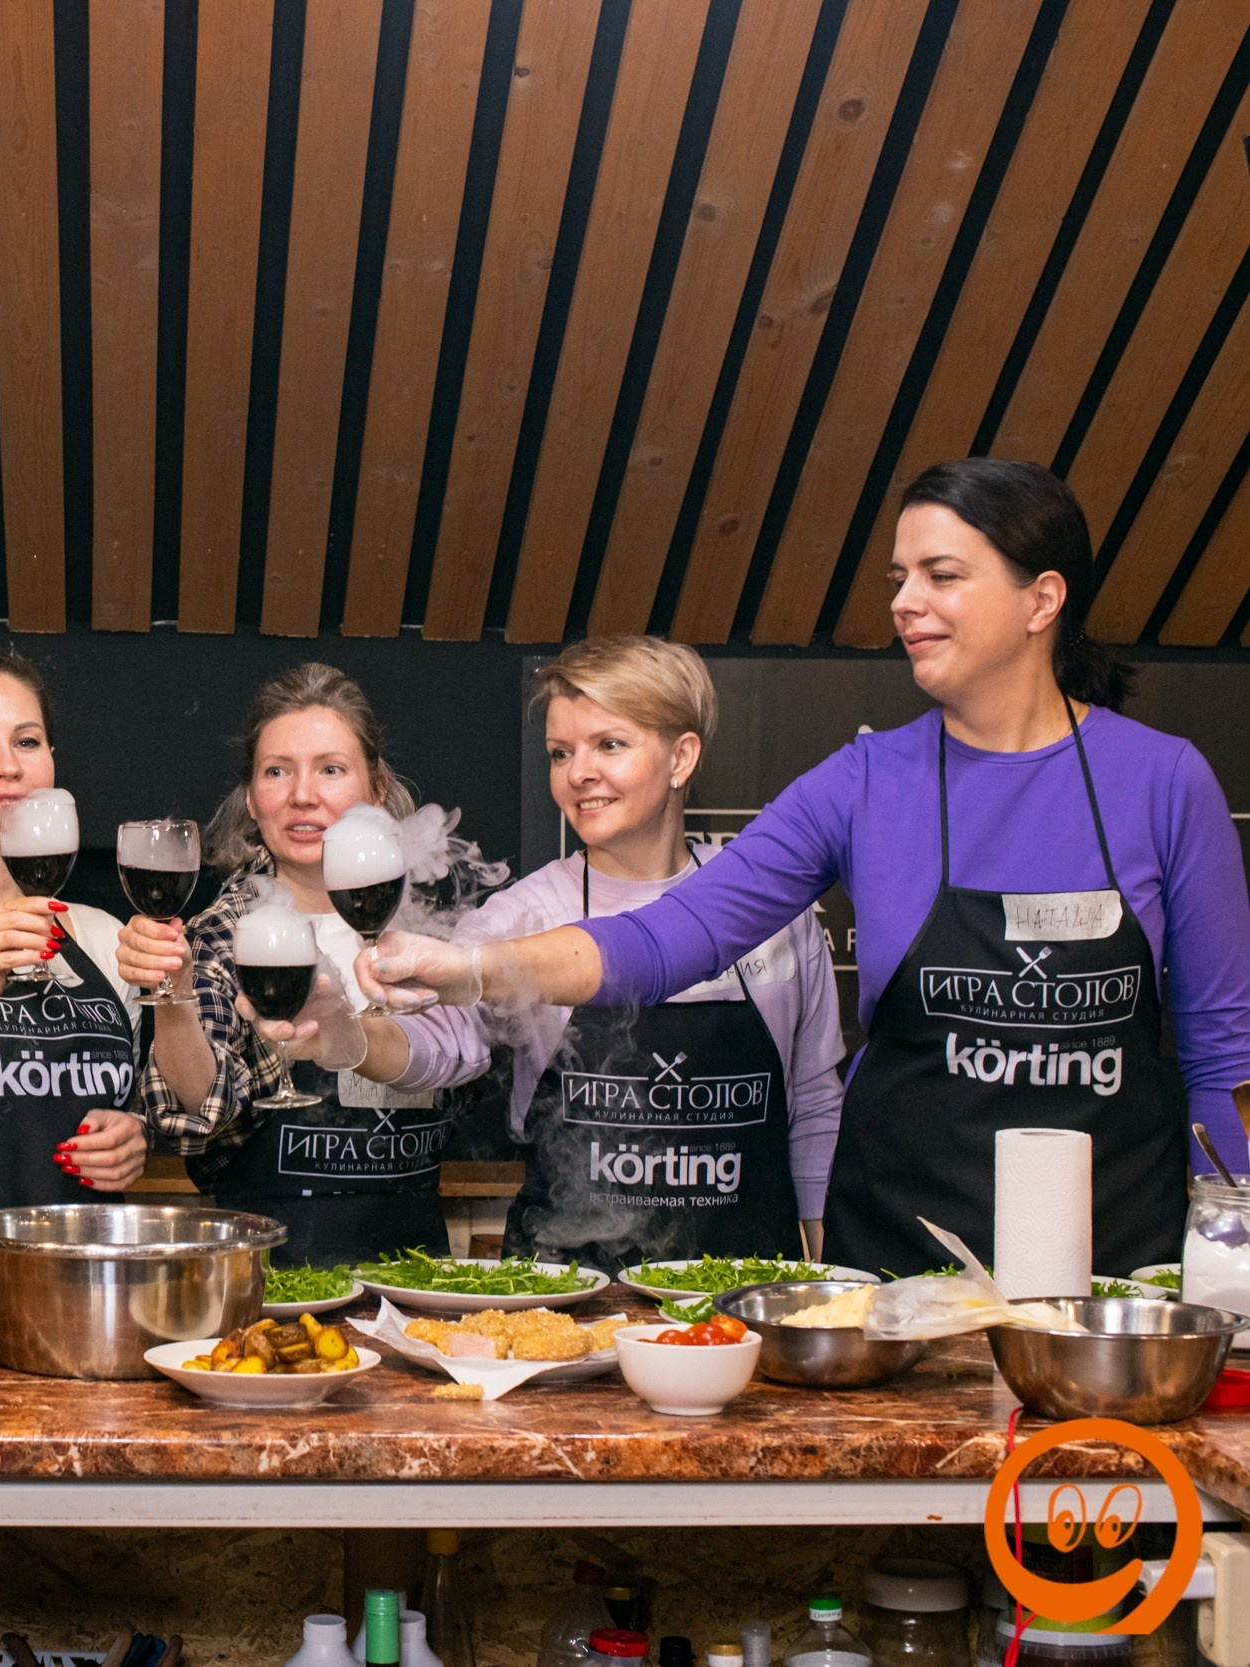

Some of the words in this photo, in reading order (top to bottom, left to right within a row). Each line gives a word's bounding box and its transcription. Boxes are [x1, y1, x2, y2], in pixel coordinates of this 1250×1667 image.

[1015, 903, 1104, 931] НАТАША
[928, 974, 1004, 1006] ИГРА
[1011, 974, 1135, 1009] СТОЛОВ
[960, 1003, 1045, 1020] КУЛИНАРНАЯ
[1052, 1008, 1105, 1021] СТУДИЯ
[1059, 1039, 1088, 1050] since
[1091, 1035, 1116, 1048] 1889
[90, 1050, 112, 1060] since
[945, 1031, 1123, 1097] körting
[568, 1078, 641, 1109] ИГРА
[648, 1080, 764, 1110] СТОЛОВ
[594, 1109, 680, 1121] КУЛИНАРНАЯ
[686, 1111, 735, 1121] СТУДИЯ
[287, 1131, 359, 1160] ИГРА
[714, 1142, 737, 1152] 1889
[314, 1161, 393, 1172] КУЛИНАРНАЯ
[589, 1141, 742, 1194] körting
[588, 1191, 686, 1208] встраиваемая
[689, 1192, 739, 1208] техника
